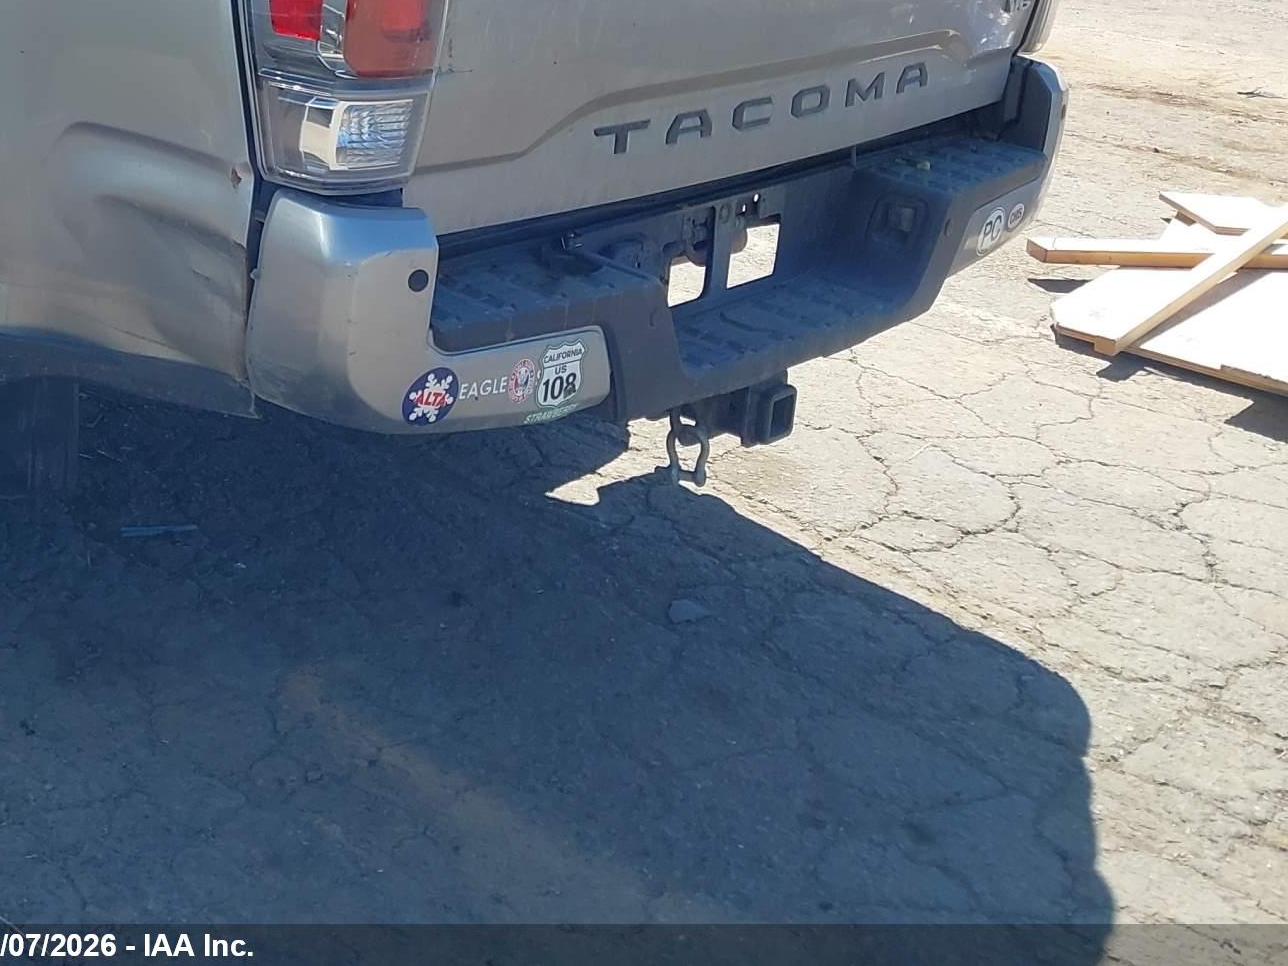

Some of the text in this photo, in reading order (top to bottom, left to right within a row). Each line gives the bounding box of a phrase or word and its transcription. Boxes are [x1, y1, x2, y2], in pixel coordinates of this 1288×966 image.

[593, 62, 930, 154] TACOMA
[543, 348, 583, 364] CALIFORNIA
[554, 365, 567, 375] US
[458, 376, 508, 400] EAGLE
[542, 372, 577, 403] 108
[415, 390, 447, 408] ALTA
